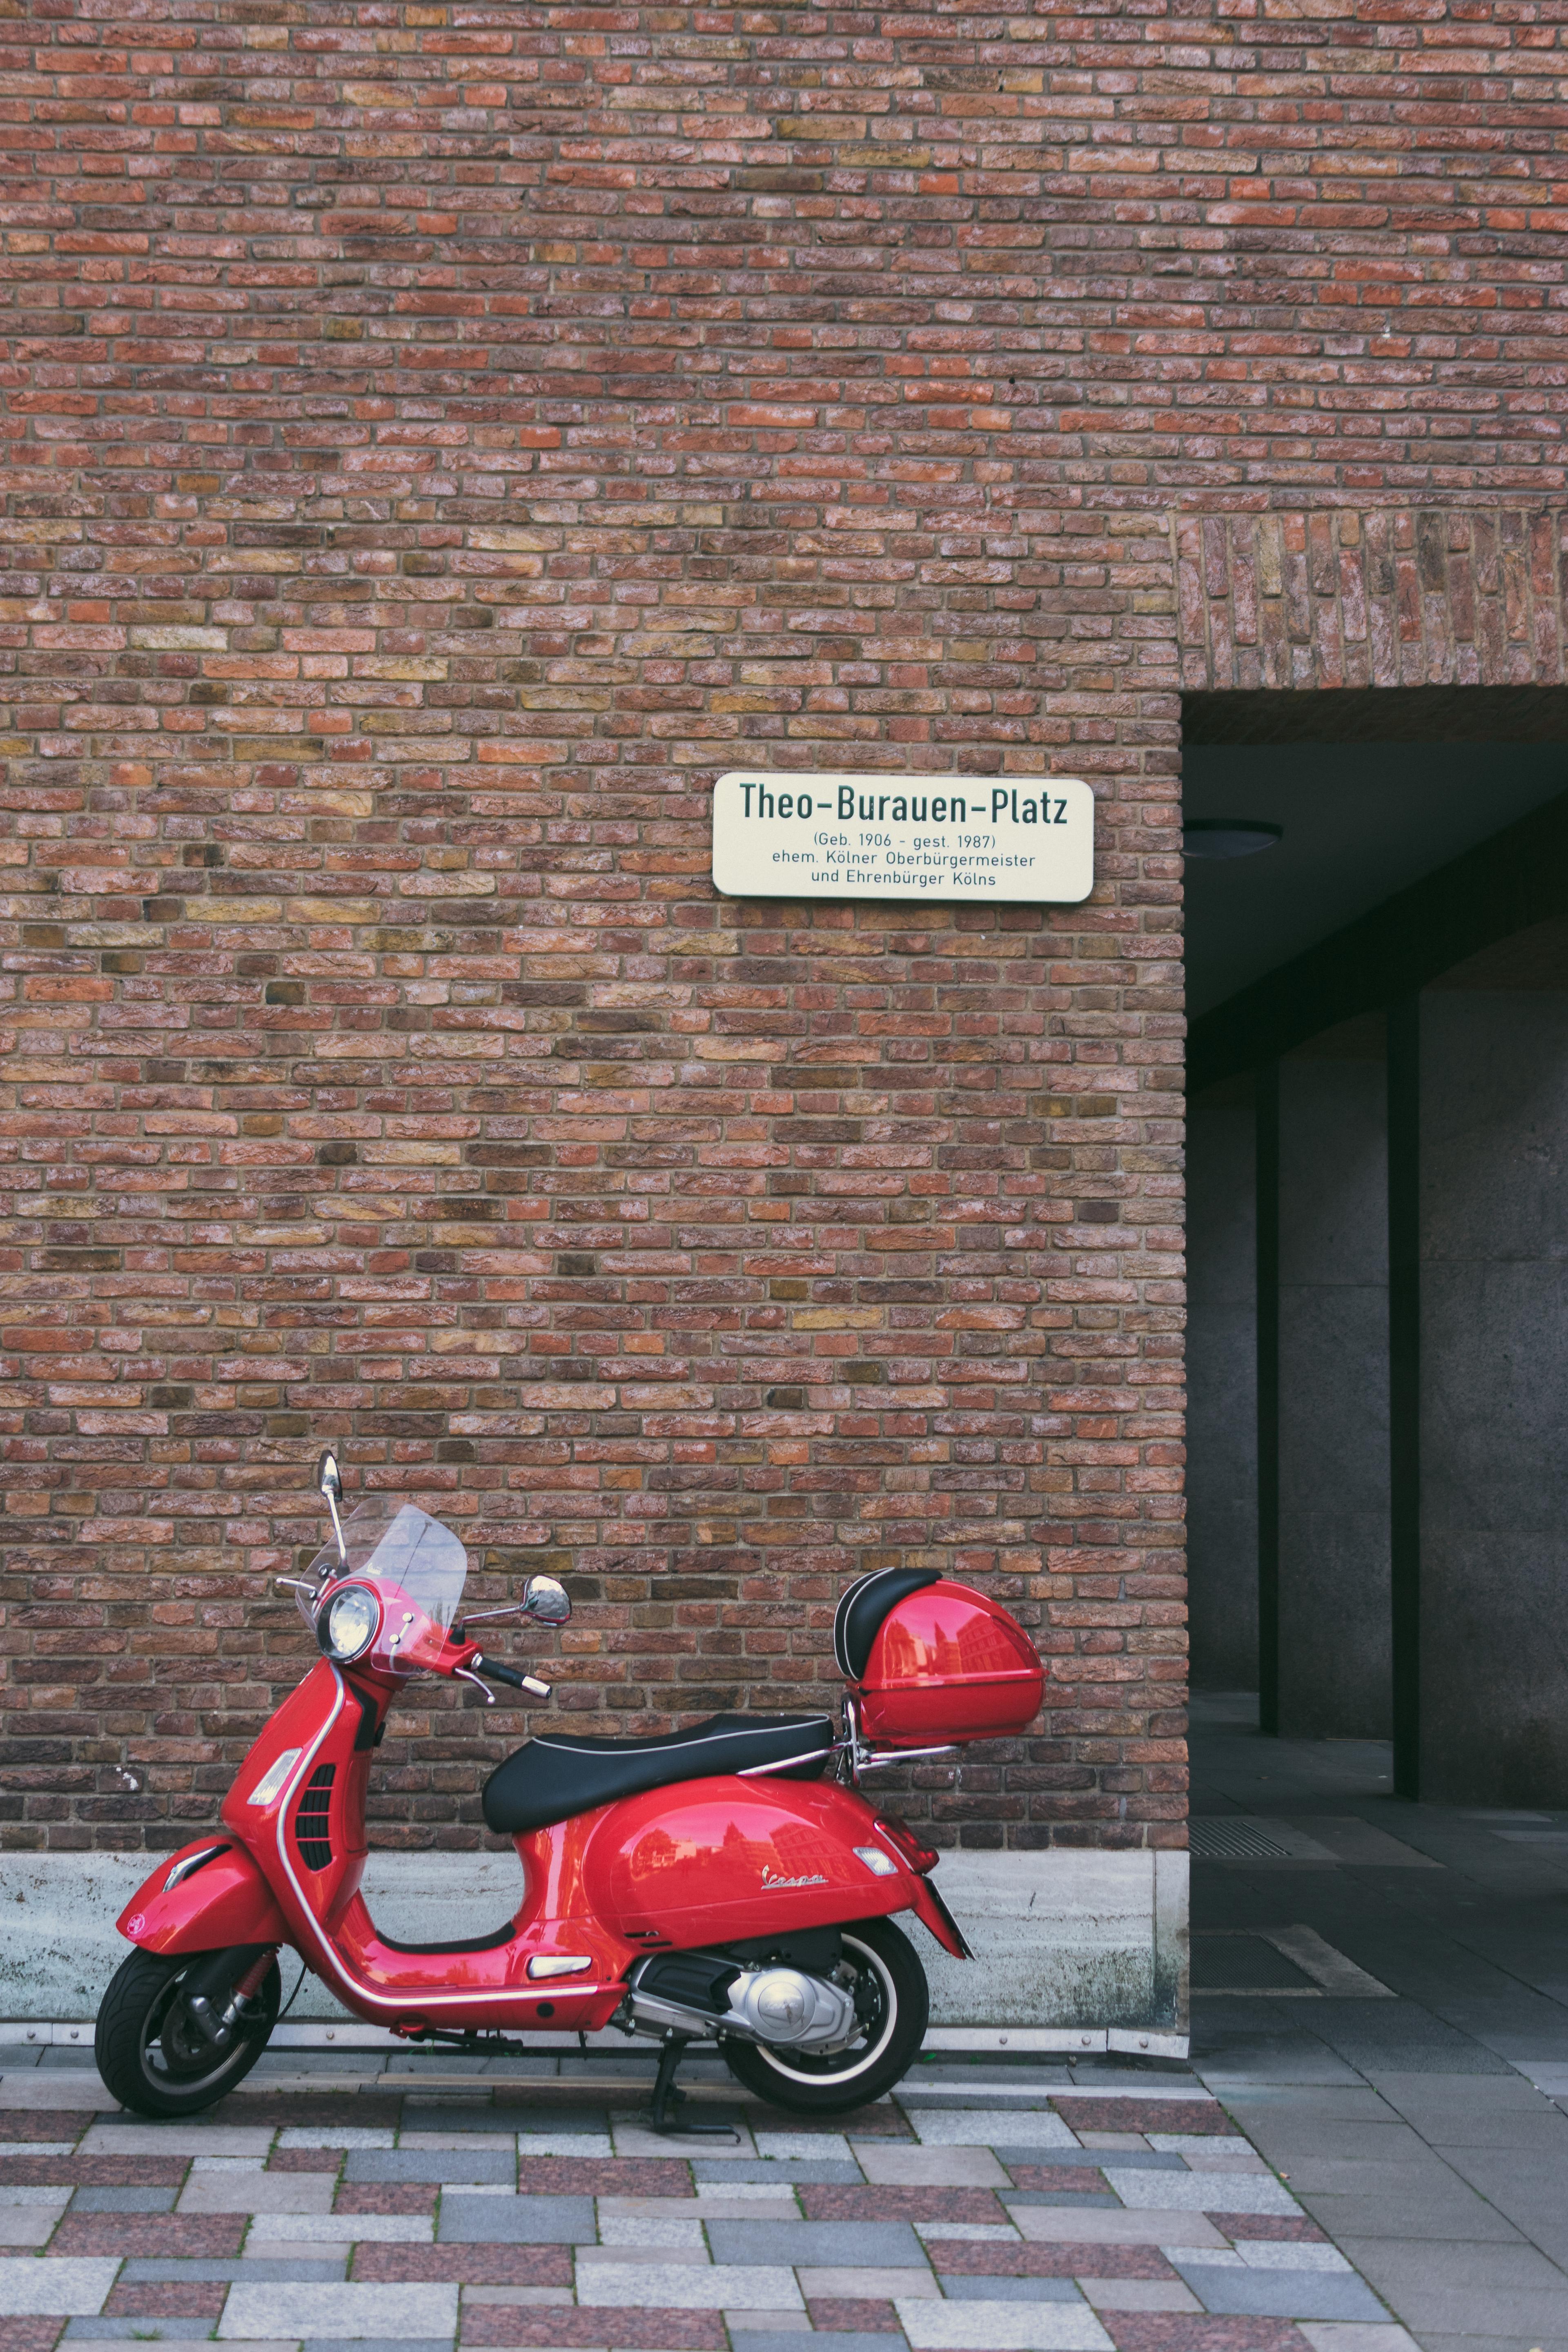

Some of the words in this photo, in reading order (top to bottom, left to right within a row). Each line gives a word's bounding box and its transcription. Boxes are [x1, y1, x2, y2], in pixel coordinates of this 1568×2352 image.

[739, 783, 1068, 824] Theo-Burauen-Platz
[814, 832, 851, 846] (Geb.
[859, 833, 891, 846] 1906
[913, 836, 949, 851] gest.
[958, 835, 996, 849] 1987)
[773, 849, 818, 863] ehem.
[827, 851, 878, 864] Kölner
[886, 851, 1036, 869] Oberbürgermeister
[811, 869, 839, 882] und
[847, 870, 945, 887] Ehrenbürger
[953, 872, 996, 886] Kölns
[761, 1864, 829, 1890] Vespa
